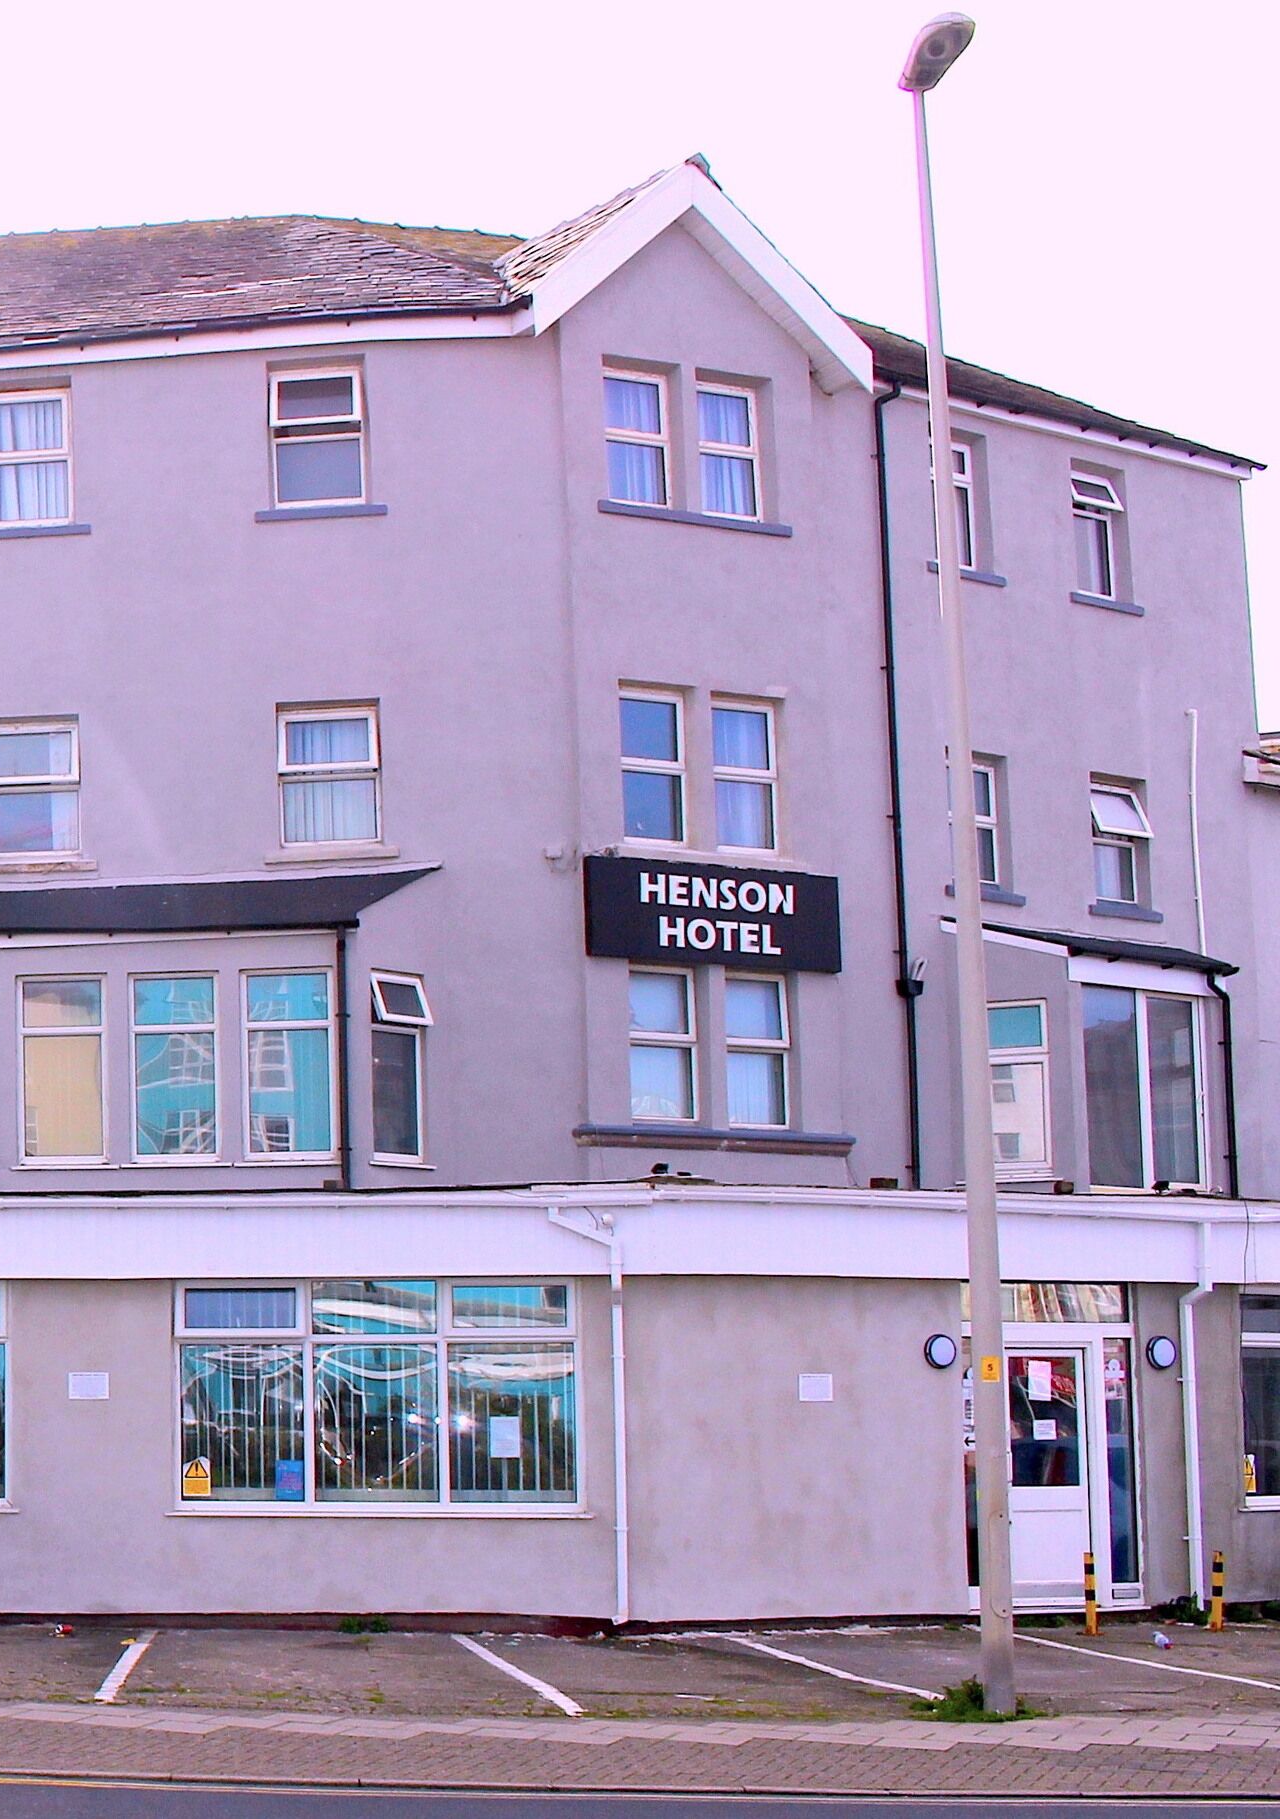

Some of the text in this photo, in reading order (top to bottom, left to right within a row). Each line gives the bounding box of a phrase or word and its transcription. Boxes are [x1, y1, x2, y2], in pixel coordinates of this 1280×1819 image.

[640, 872, 794, 915] HENSON
[658, 915, 783, 956] HOTEL
[987, 1363, 993, 1371] 5
